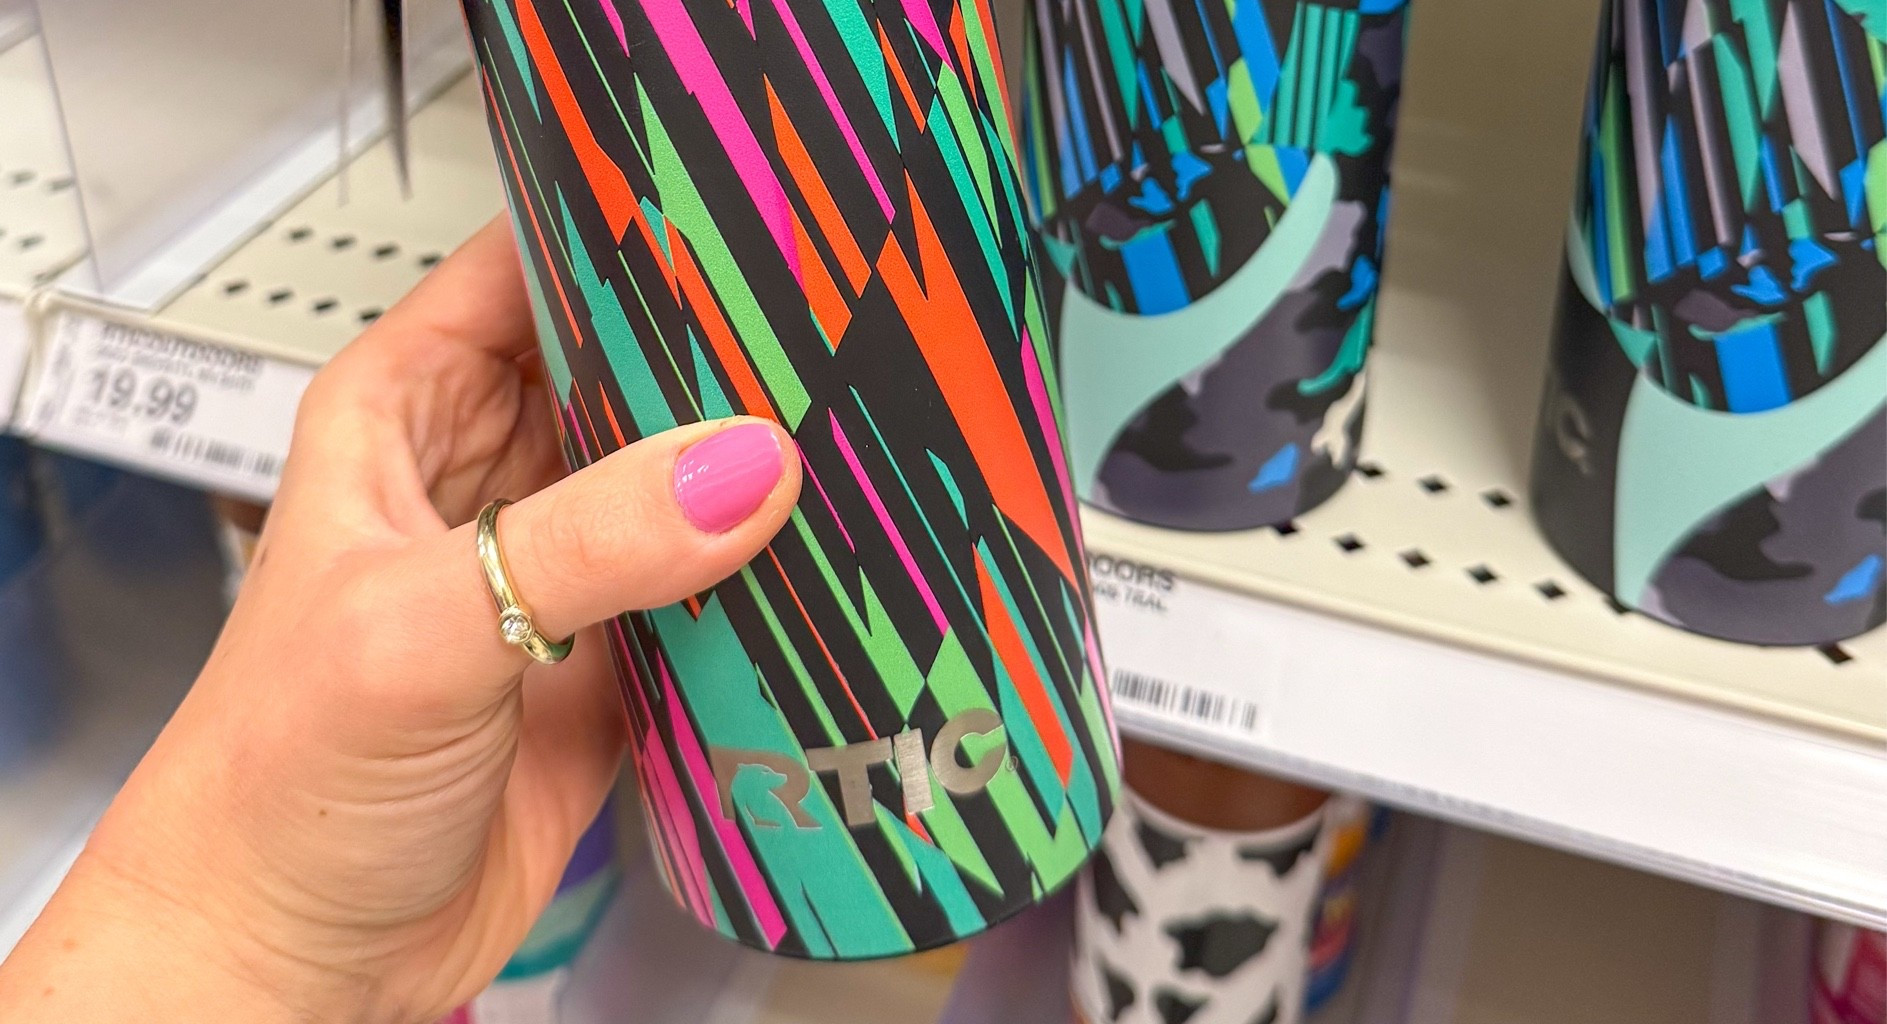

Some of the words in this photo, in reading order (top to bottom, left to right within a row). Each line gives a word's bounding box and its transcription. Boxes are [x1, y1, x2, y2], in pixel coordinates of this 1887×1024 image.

[91, 365, 199, 424] 19.99
[1090, 554, 1173, 591] OORS
[709, 707, 1006, 830] RTIC
